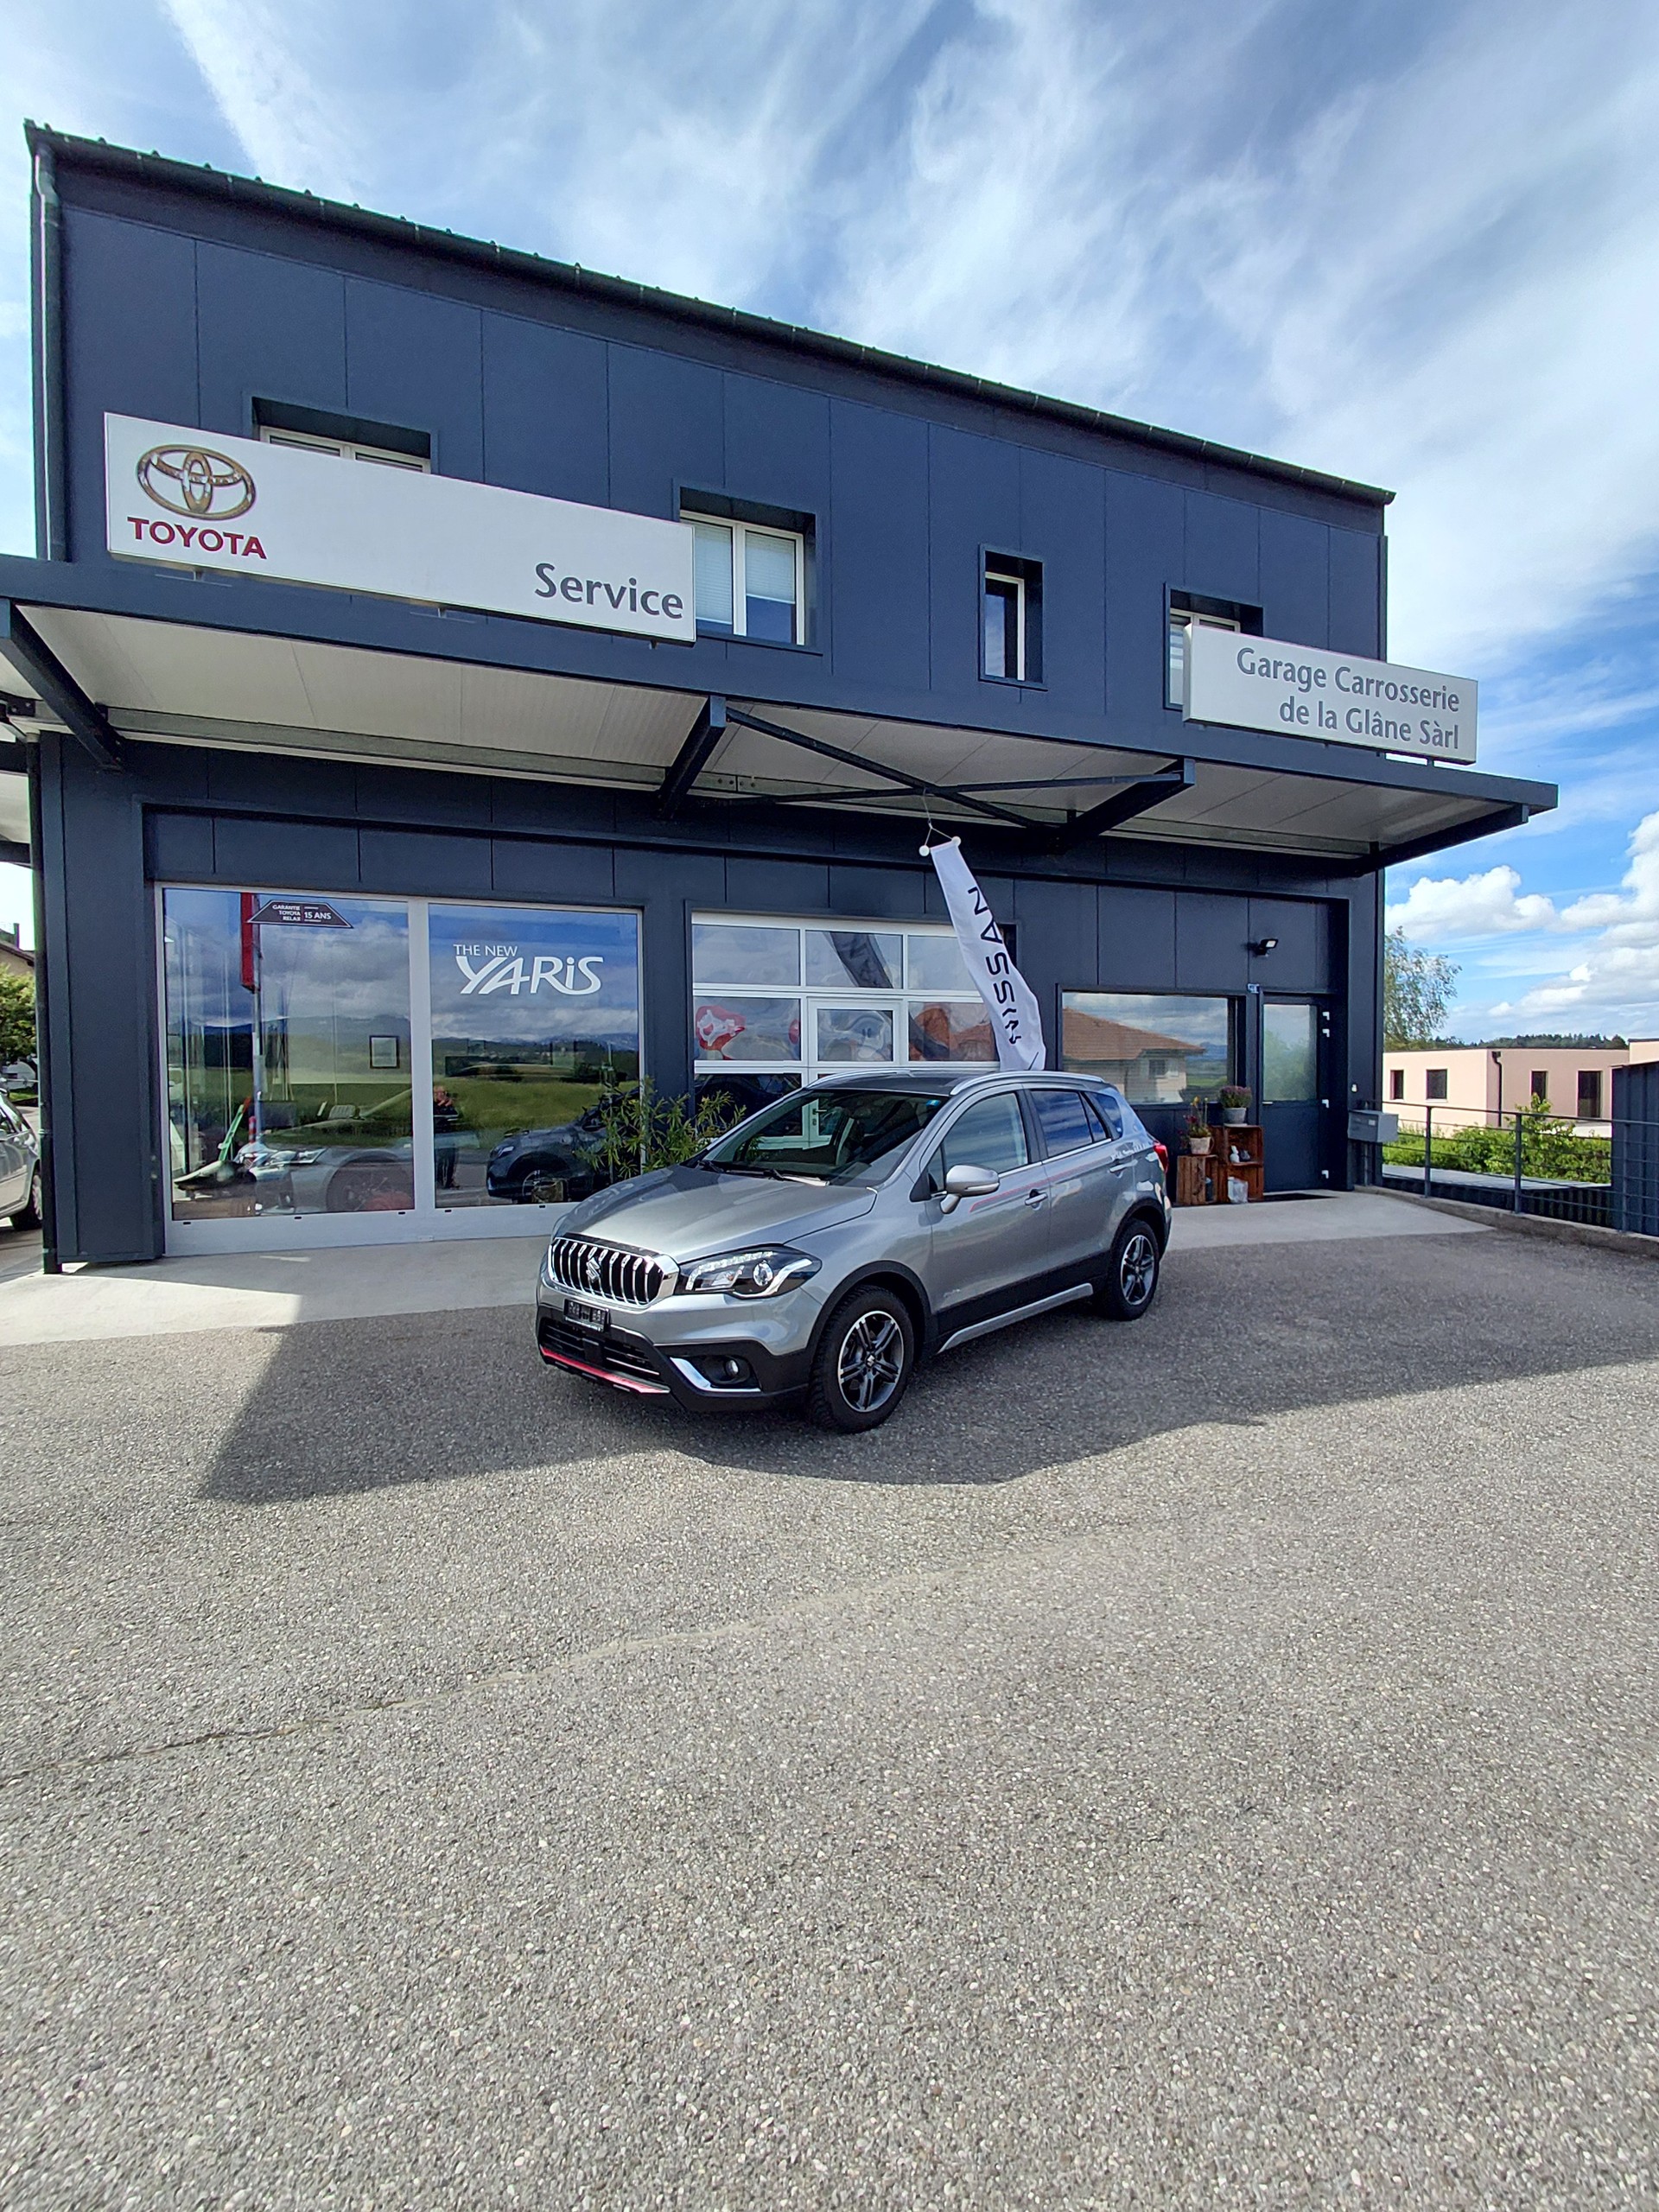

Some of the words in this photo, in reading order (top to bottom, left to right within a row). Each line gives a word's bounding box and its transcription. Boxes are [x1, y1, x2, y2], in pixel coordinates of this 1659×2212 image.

[127, 516, 267, 560] TOYOTA
[534, 563, 683, 620] Service
[1236, 647, 1327, 693] Garage
[1335, 666, 1460, 713] Carrosserie
[1280, 696, 1309, 725] de
[1319, 701, 1338, 730] la
[1345, 707, 1412, 742] Glâne
[1419, 719, 1459, 749] Sàrl
[454, 944, 480, 956] THE
[485, 945, 518, 957] NEW
[968, 887, 1022, 1045] NISSAN
